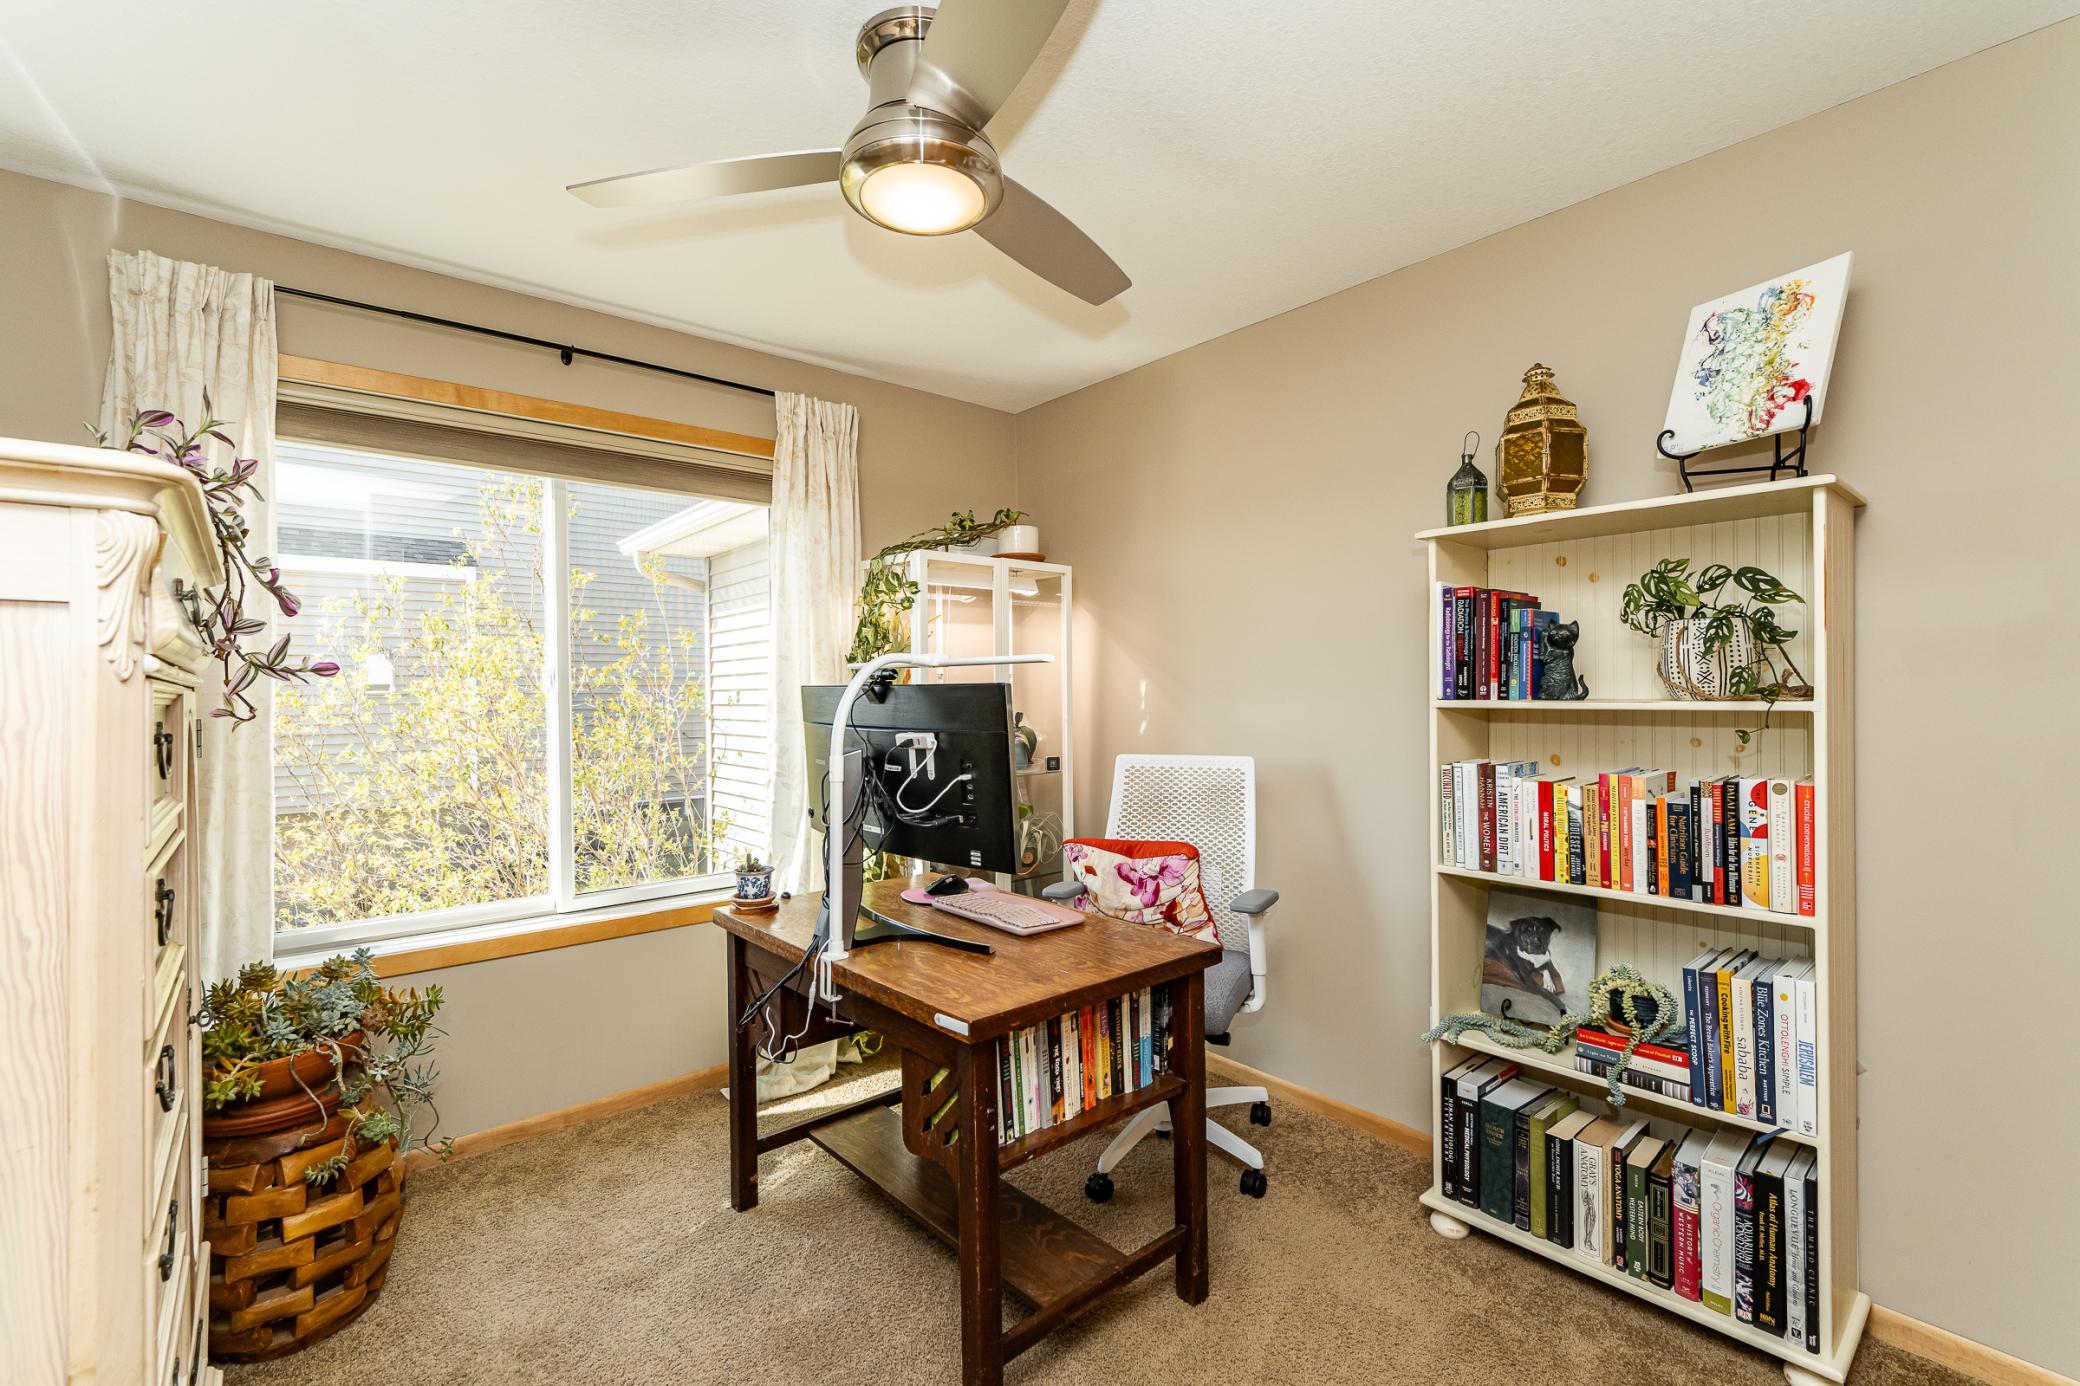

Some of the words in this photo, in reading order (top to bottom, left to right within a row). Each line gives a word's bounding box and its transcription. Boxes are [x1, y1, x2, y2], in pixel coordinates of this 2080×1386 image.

[1442, 768, 1452, 800] VACCINATED
[1727, 785, 1736, 811] DALAI
[1498, 791, 1508, 835] AMERICAN
[1669, 815, 1677, 826] for
[1727, 811, 1736, 836] LAMA
[1748, 801, 1757, 832] GENE
[1803, 800, 1811, 823] crucial
[1483, 822, 1491, 854] WOMEN
[1499, 837, 1509, 856] DIRT
[1569, 814, 1581, 853] MIDDLESEX
[1669, 828, 1678, 864] Clinicians
[1679, 815, 1687, 851] Nutrition
[1803, 823, 1811, 867] conversations
[1680, 851, 1688, 875] Guide
[1721, 992, 1729, 1022] Cooking
[1756, 986, 1768, 1008] Blue
[1705, 1024, 1713, 1042] Bread
[1757, 1008, 1769, 1037] Zones
[1723, 1040, 1731, 1054] Fire
[1780, 1014, 1789, 1066] OTTOLENGHI
[1737, 1036, 1752, 1080] sababa
[1758, 1039, 1770, 1075] Kitchen
[1798, 1040, 1815, 1087] JERUSALEM
[1707, 1064, 1716, 1097] Apprentice
[1782, 1067, 1790, 1095] SIMPLE
[1580, 1147, 1588, 1190] ANATOMY
[1588, 1157, 1597, 1186] GRAY'S
[1768, 1193, 1778, 1212] Atlas
[1710, 1201, 1722, 1236] Organic
[1735, 1222, 1744, 1243] POND
[1769, 1213, 1777, 1223] of
[1789, 1189, 1799, 1250] LONGUEVUE
[1807, 1210, 1815, 1229] THE
[1736, 1243, 1745, 1262] FISH
[1744, 1219, 1753, 1264] AQUARIUM
[1768, 1224, 1778, 1251] Human
[1711, 1237, 1722, 1281] Chemistry
[1767, 1254, 1777, 1288] Anatomy
[1791, 1271, 1800, 1282] and
[1808, 1270, 1816, 1307] CLINIC
